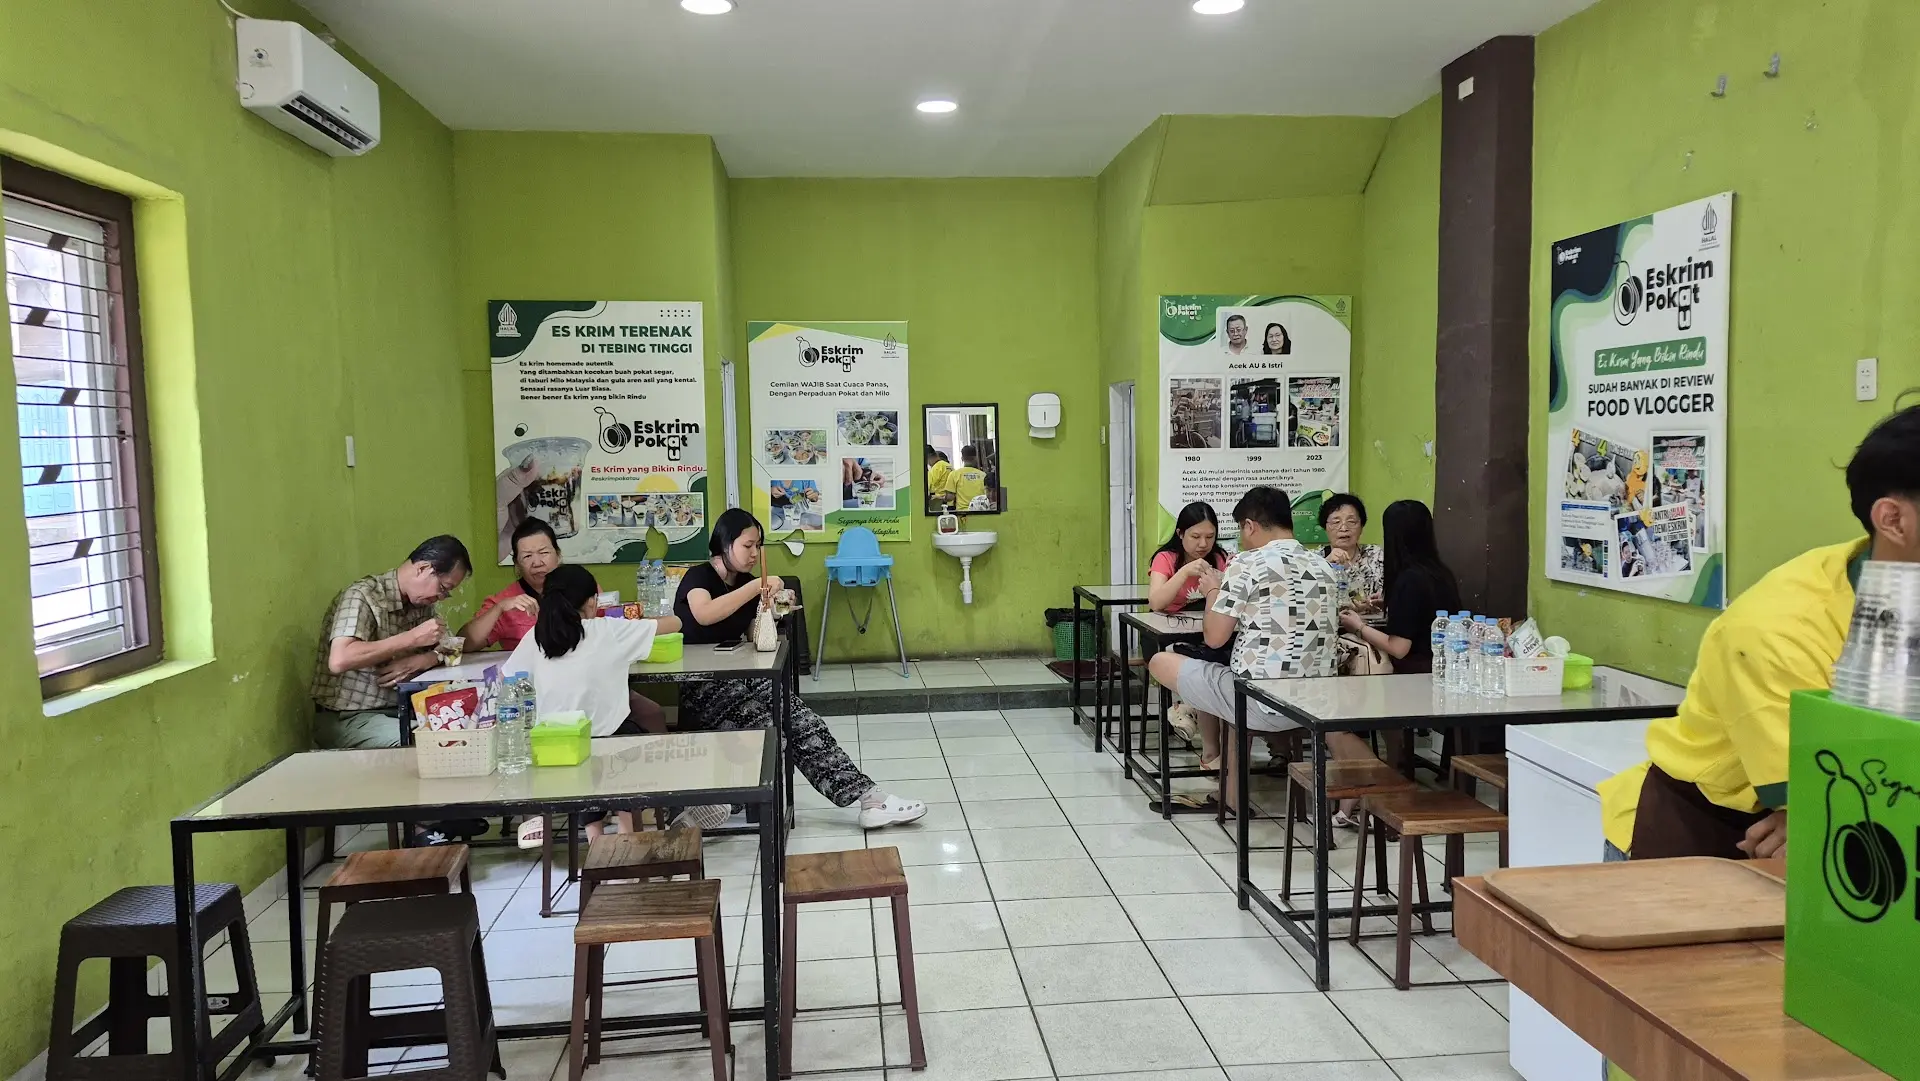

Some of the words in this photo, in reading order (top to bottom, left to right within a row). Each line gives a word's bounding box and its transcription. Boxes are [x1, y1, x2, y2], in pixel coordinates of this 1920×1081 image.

[1701, 236, 1717, 244] HALAL
[1646, 256, 1714, 290] Eskrim
[1646, 283, 1700, 312] Pokat
[552, 326, 570, 338] ES
[575, 326, 615, 338] KRIM
[619, 326, 692, 338] TERENAK
[581, 344, 595, 354] DI
[598, 344, 646, 354] TEBING
[649, 344, 692, 354] TINGGI
[821, 345, 864, 355] Eskrim
[821, 356, 856, 364] Pokat
[1609, 353, 1629, 368] Krim
[1630, 350, 1652, 371] Yang
[1653, 345, 1677, 363] Bikin
[1678, 342, 1704, 360] Rindu
[1588, 382, 1618, 394] SUDAH
[1620, 378, 1658, 392] BANYAK
[1660, 378, 1671, 388] DI
[1673, 374, 1715, 388] REVIEW
[1588, 398, 1630, 417] FOOD
[1633, 393, 1715, 415] VLOGGER
[634, 419, 700, 434] Eskrim
[634, 435, 688, 448] Pokat
[837, 517, 867, 527] Segarnya
[1668, 520, 1687, 532] ESKRIM
